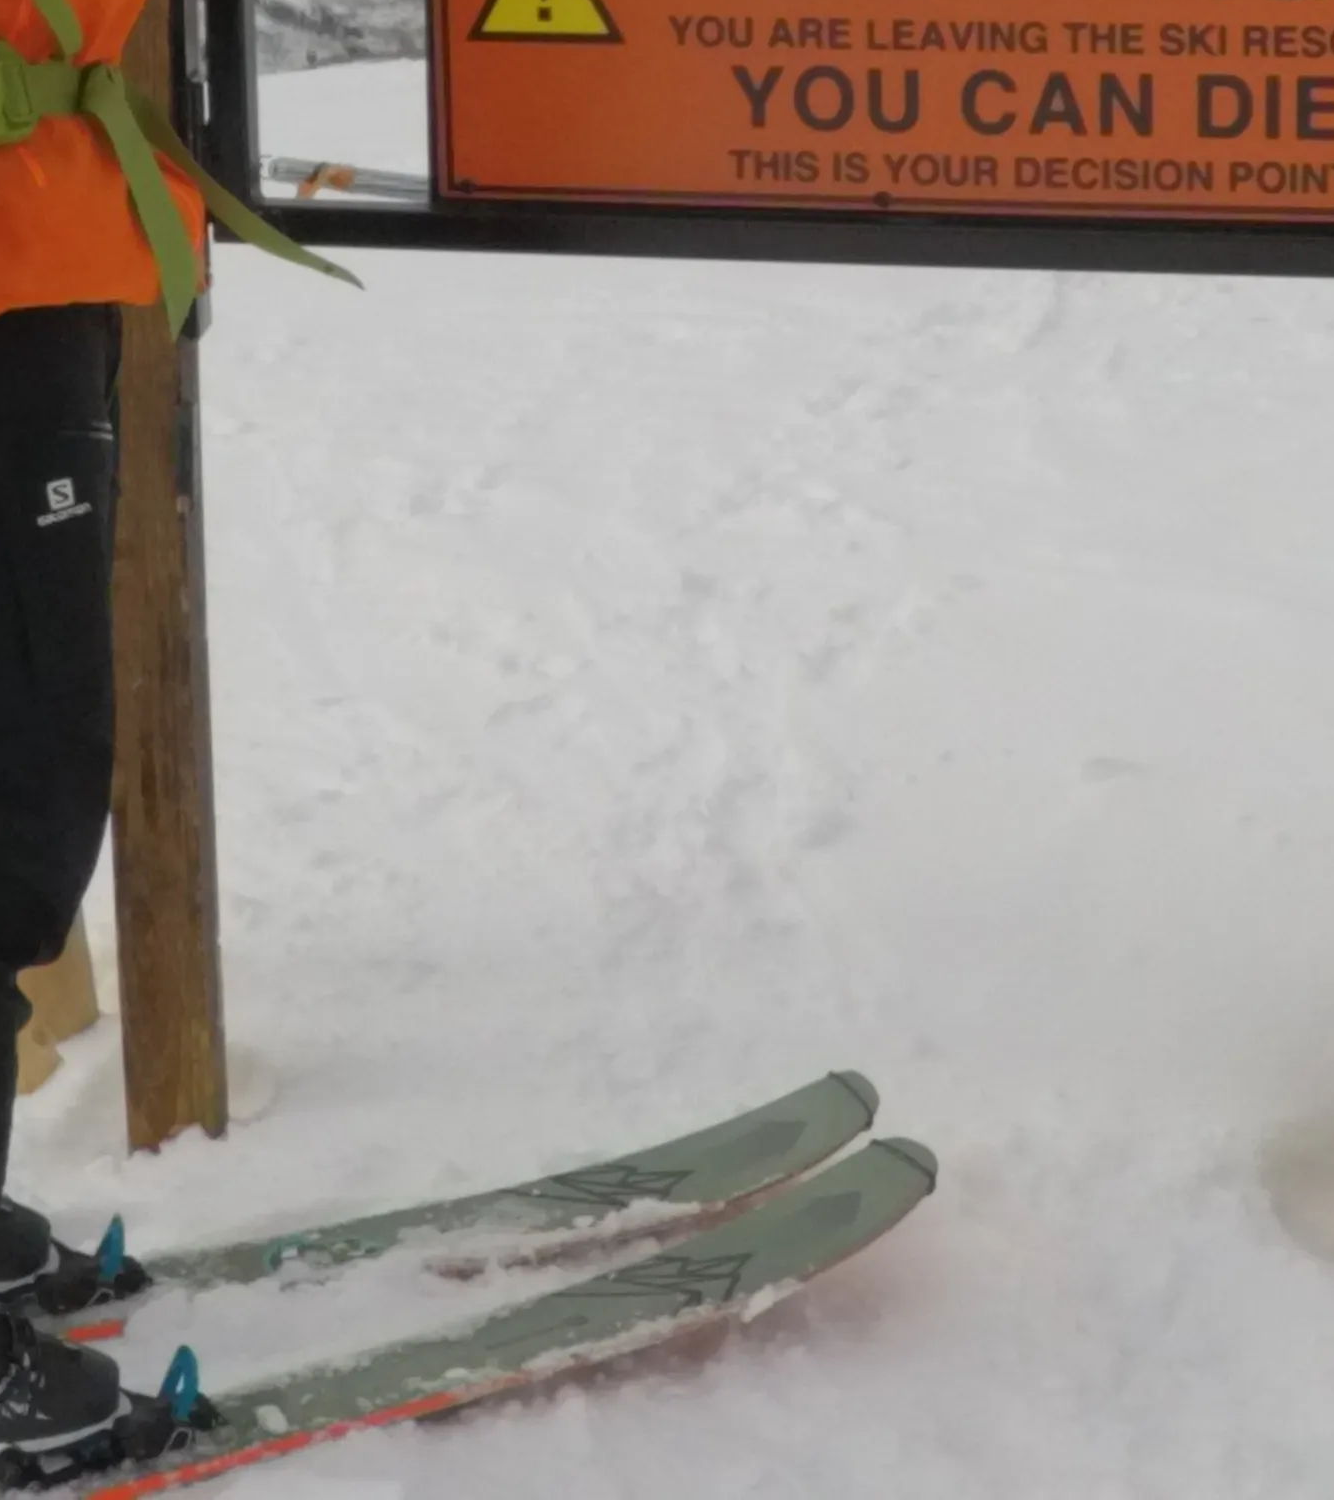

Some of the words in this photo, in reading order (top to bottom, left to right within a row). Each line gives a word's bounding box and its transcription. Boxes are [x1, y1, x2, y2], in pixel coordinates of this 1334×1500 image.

[668, 14, 756, 50] YOU
[767, 16, 853, 52] ARE
[866, 18, 1049, 55] LEAVING
[1062, 21, 1146, 56] THE
[1158, 22, 1228, 57] SKI
[731, 63, 922, 135] YOU
[958, 68, 1155, 138] CAN
[727, 148, 822, 185] THIS
[831, 151, 872, 186] IS
[881, 153, 1000, 190] YOUR
[1013, 156, 1217, 194] DECISION
